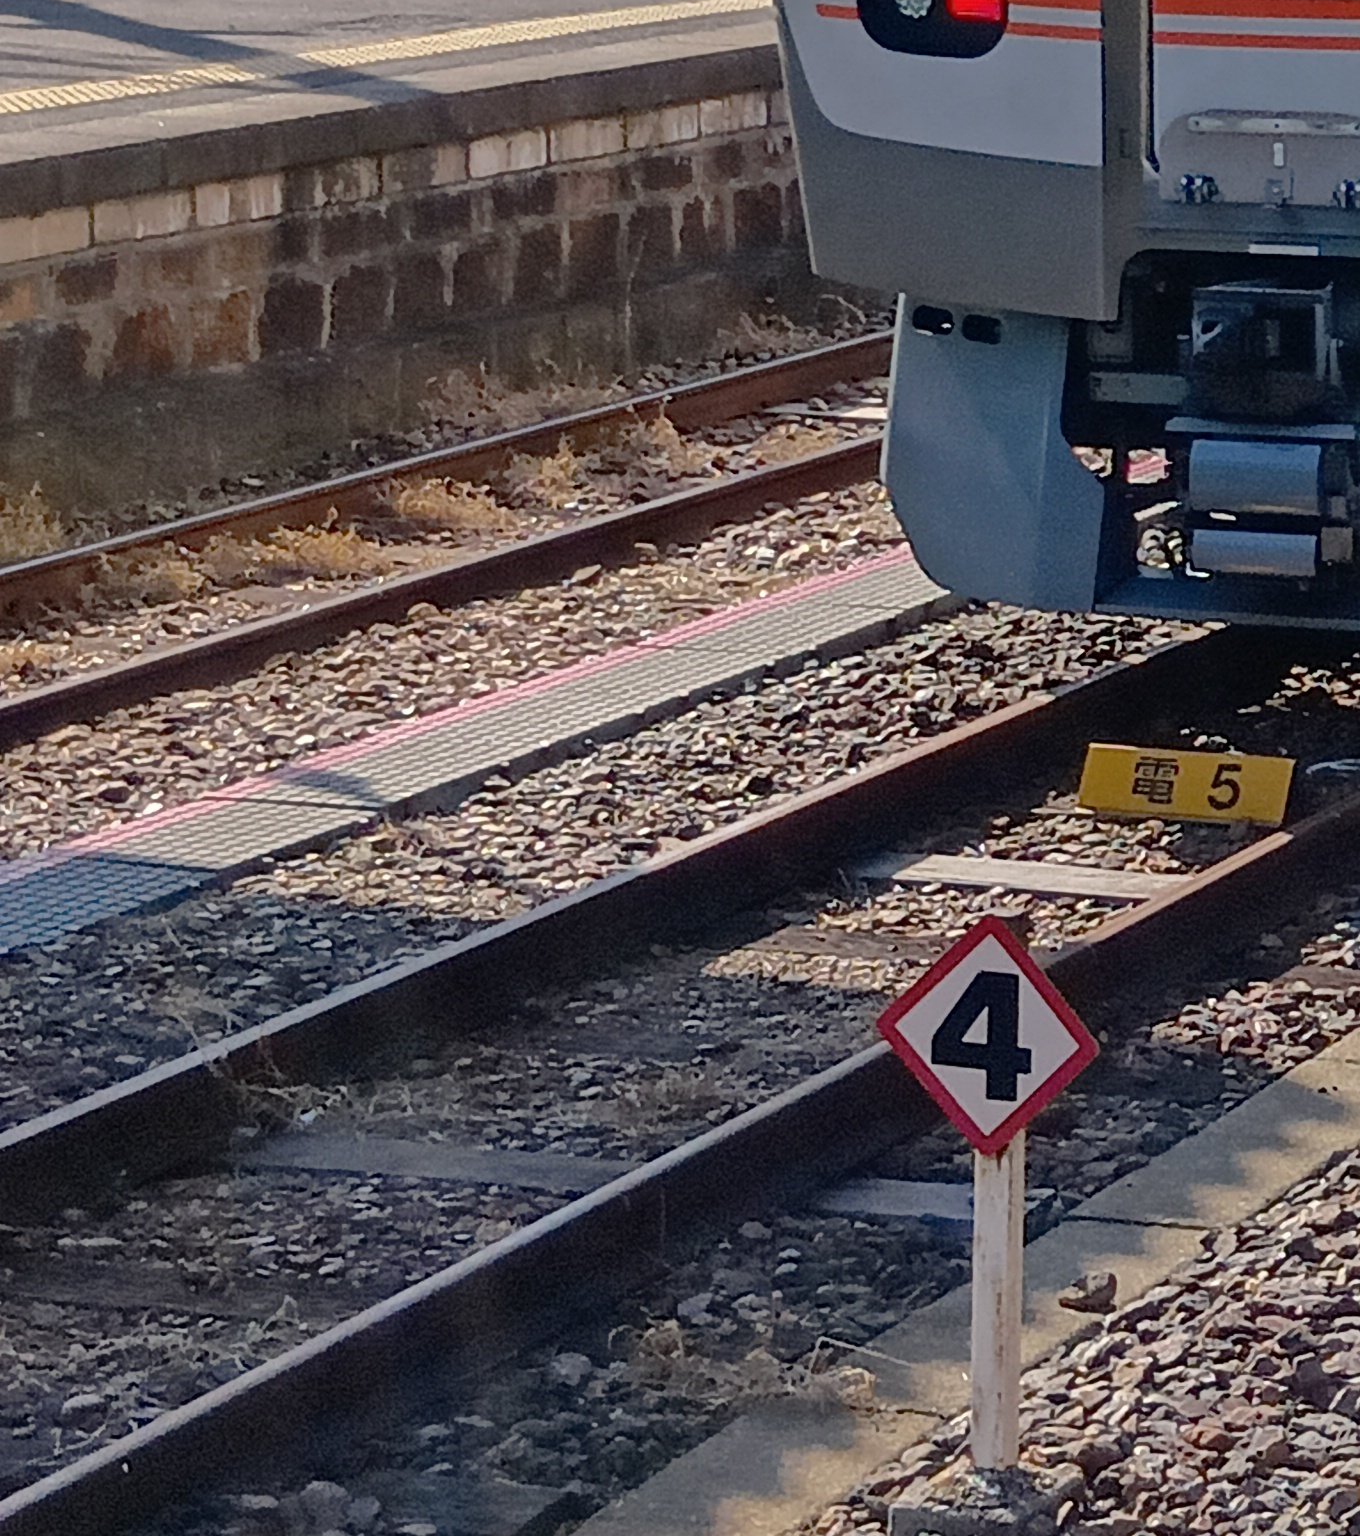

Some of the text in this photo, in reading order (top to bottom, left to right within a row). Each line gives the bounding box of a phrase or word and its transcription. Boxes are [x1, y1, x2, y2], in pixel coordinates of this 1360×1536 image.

[1131, 756, 1243, 811] 電 5
[930, 969, 1033, 1102] 4
